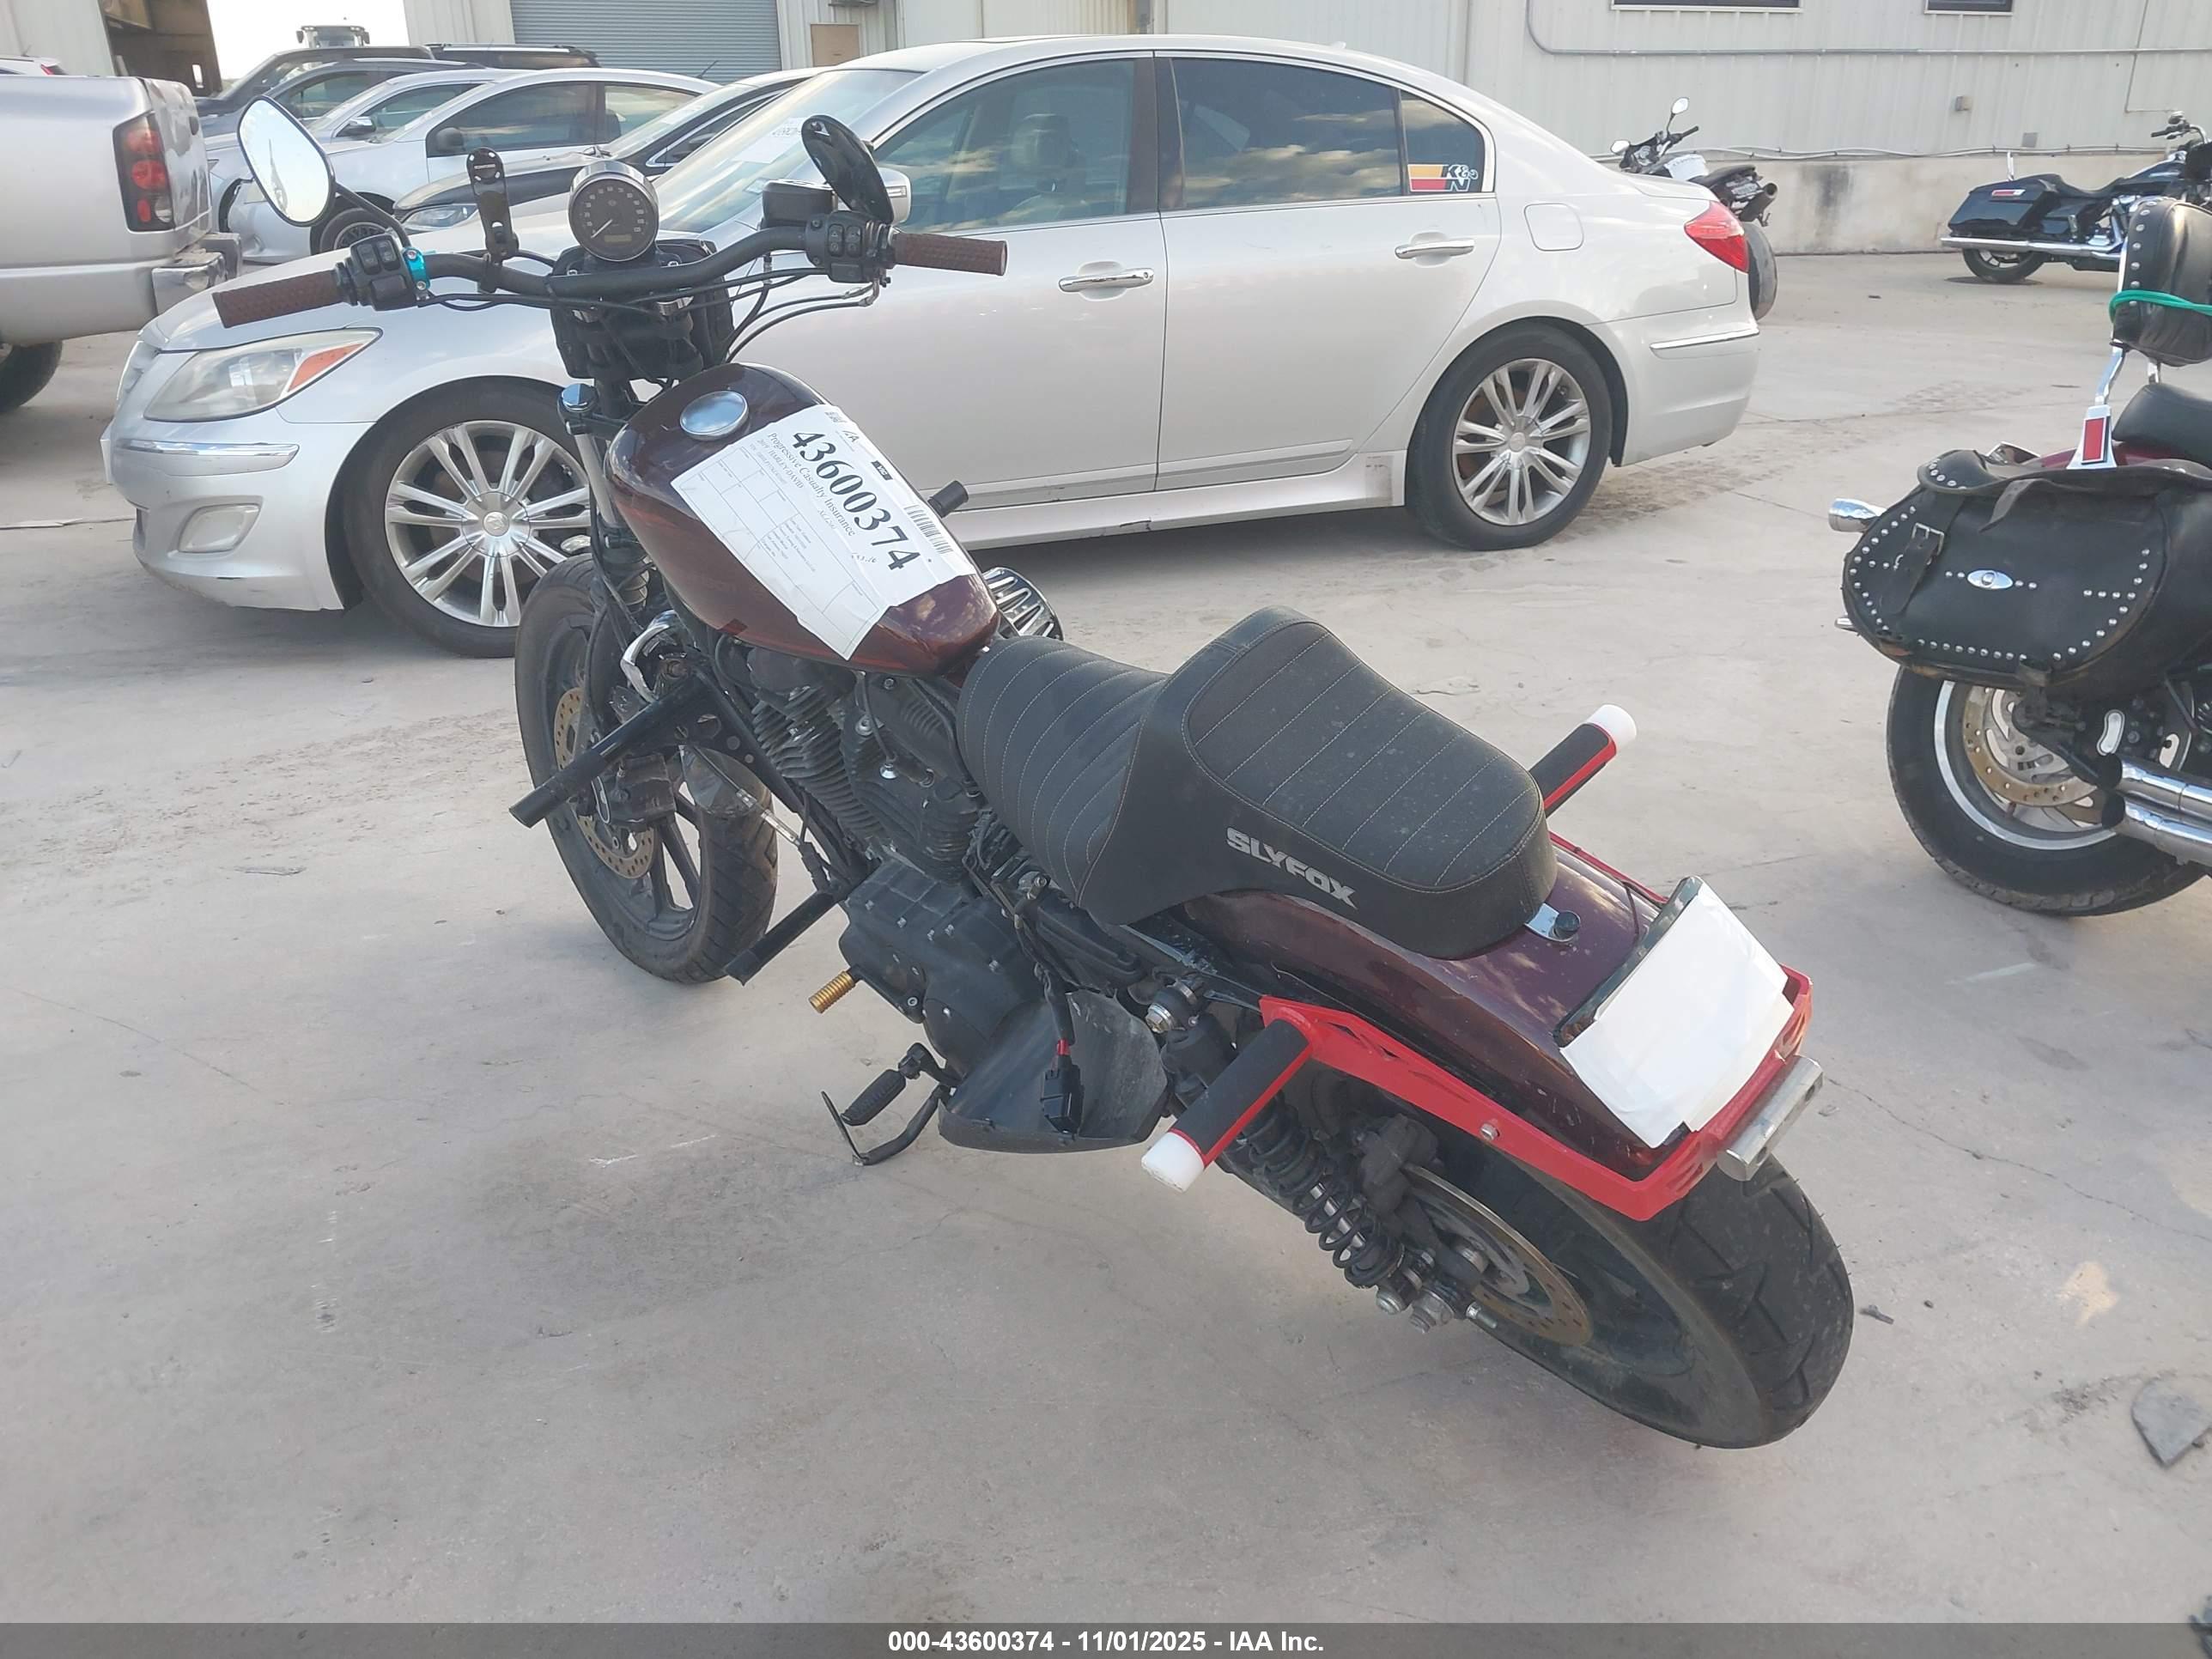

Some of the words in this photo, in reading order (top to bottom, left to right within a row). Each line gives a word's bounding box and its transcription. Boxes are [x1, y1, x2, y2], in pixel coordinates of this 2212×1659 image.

[769, 433, 801, 468] Progressive
[799, 467, 827, 498] Casualty
[824, 497, 855, 537] Insurance
[793, 433, 921, 570] 43600374
[1226, 827, 1358, 909] SLYFOX
